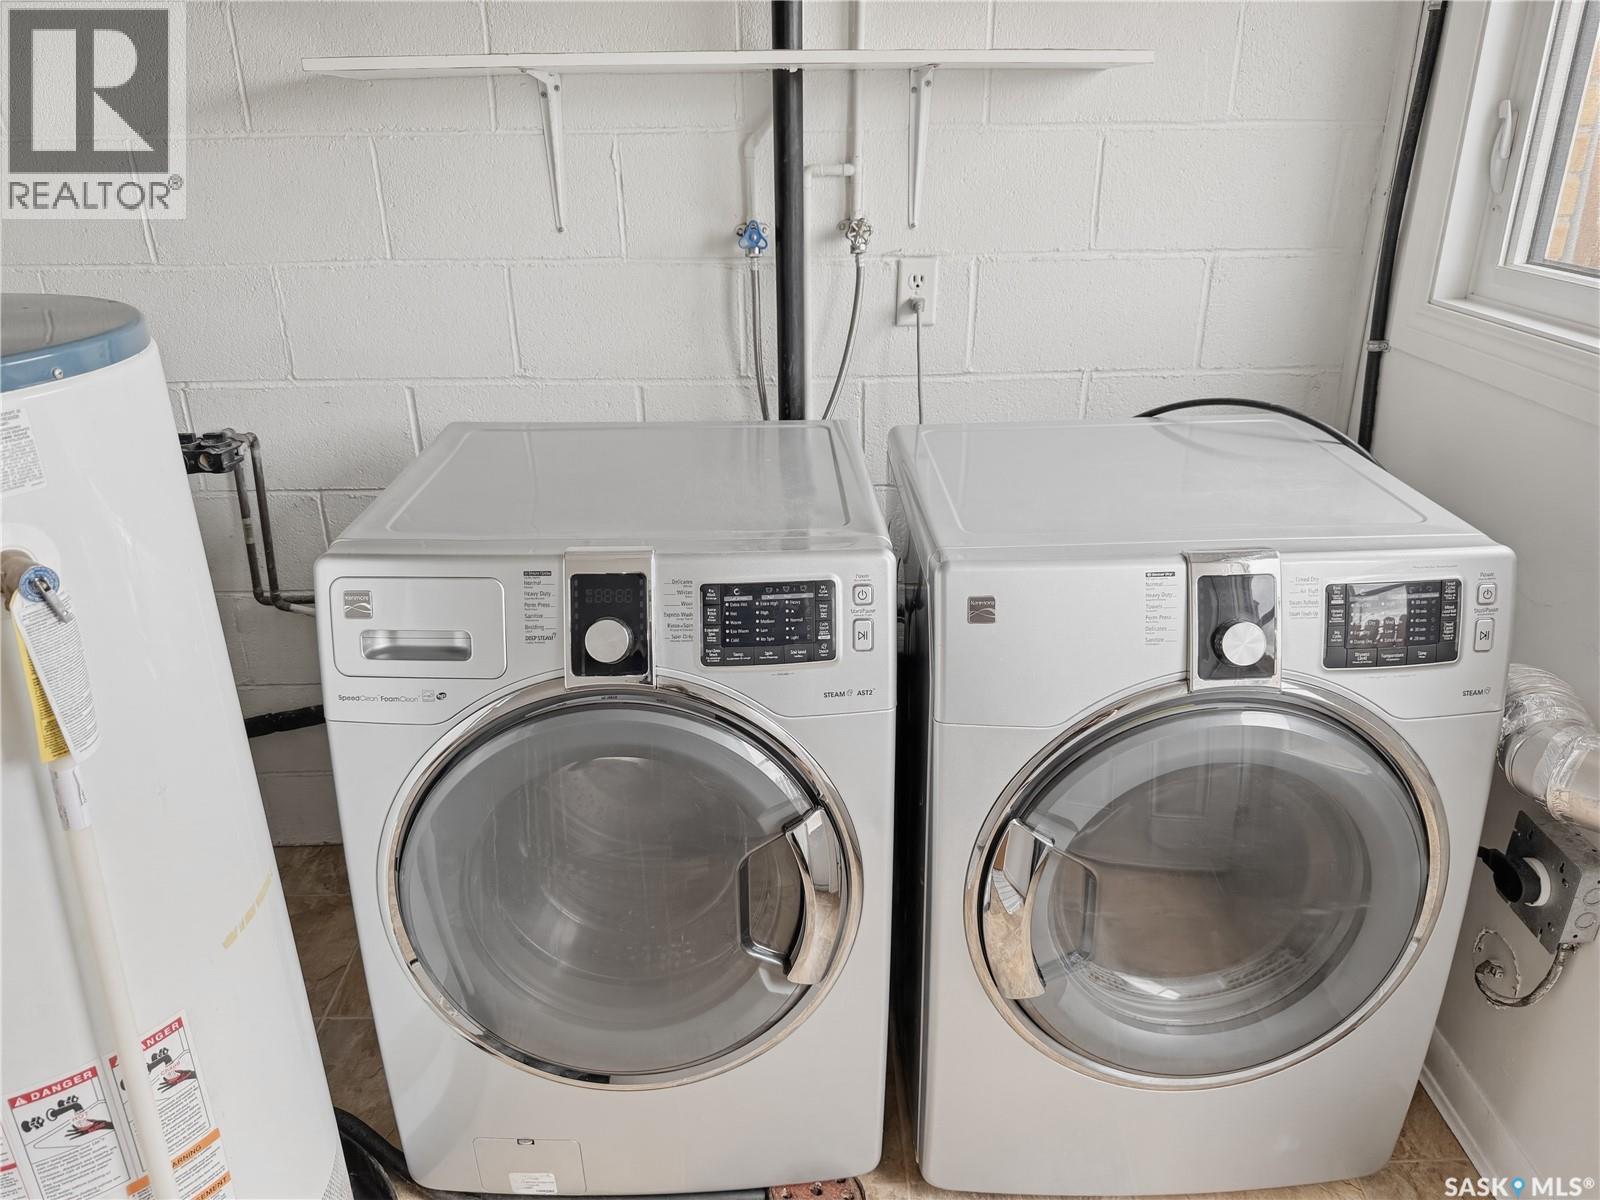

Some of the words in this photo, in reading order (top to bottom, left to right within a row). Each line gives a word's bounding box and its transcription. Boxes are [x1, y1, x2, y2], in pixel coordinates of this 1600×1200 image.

[142, 1021, 180, 1049] NGER
[30, 1069, 94, 1101] DANGER
[172, 1144, 202, 1168] ARNING
